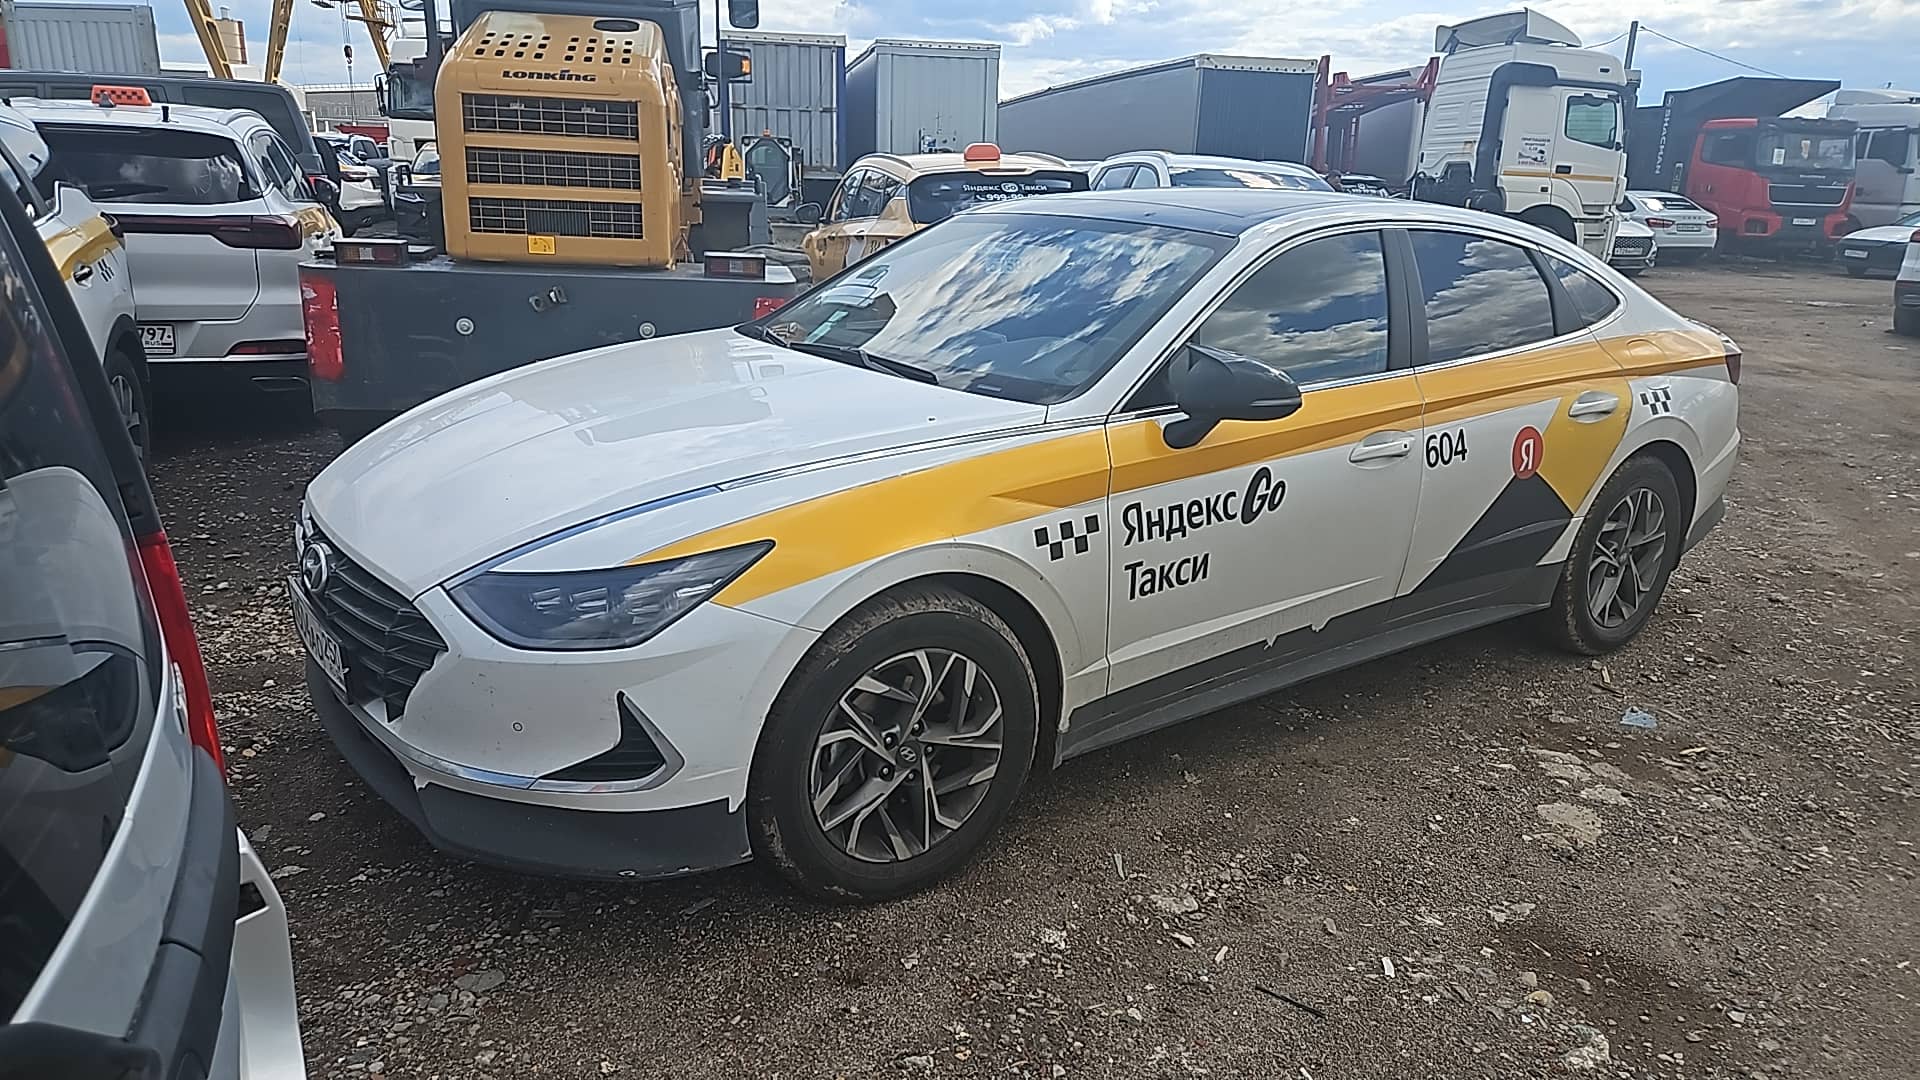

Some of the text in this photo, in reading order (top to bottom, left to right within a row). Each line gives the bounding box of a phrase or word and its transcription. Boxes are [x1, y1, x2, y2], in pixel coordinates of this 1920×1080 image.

[137, 327, 166, 340] 797
[1425, 428, 1468, 468] 604
[1519, 438, 1535, 472] Я
[1122, 466, 1287, 547] Яндекс Go
[1123, 552, 1210, 601] Такси
